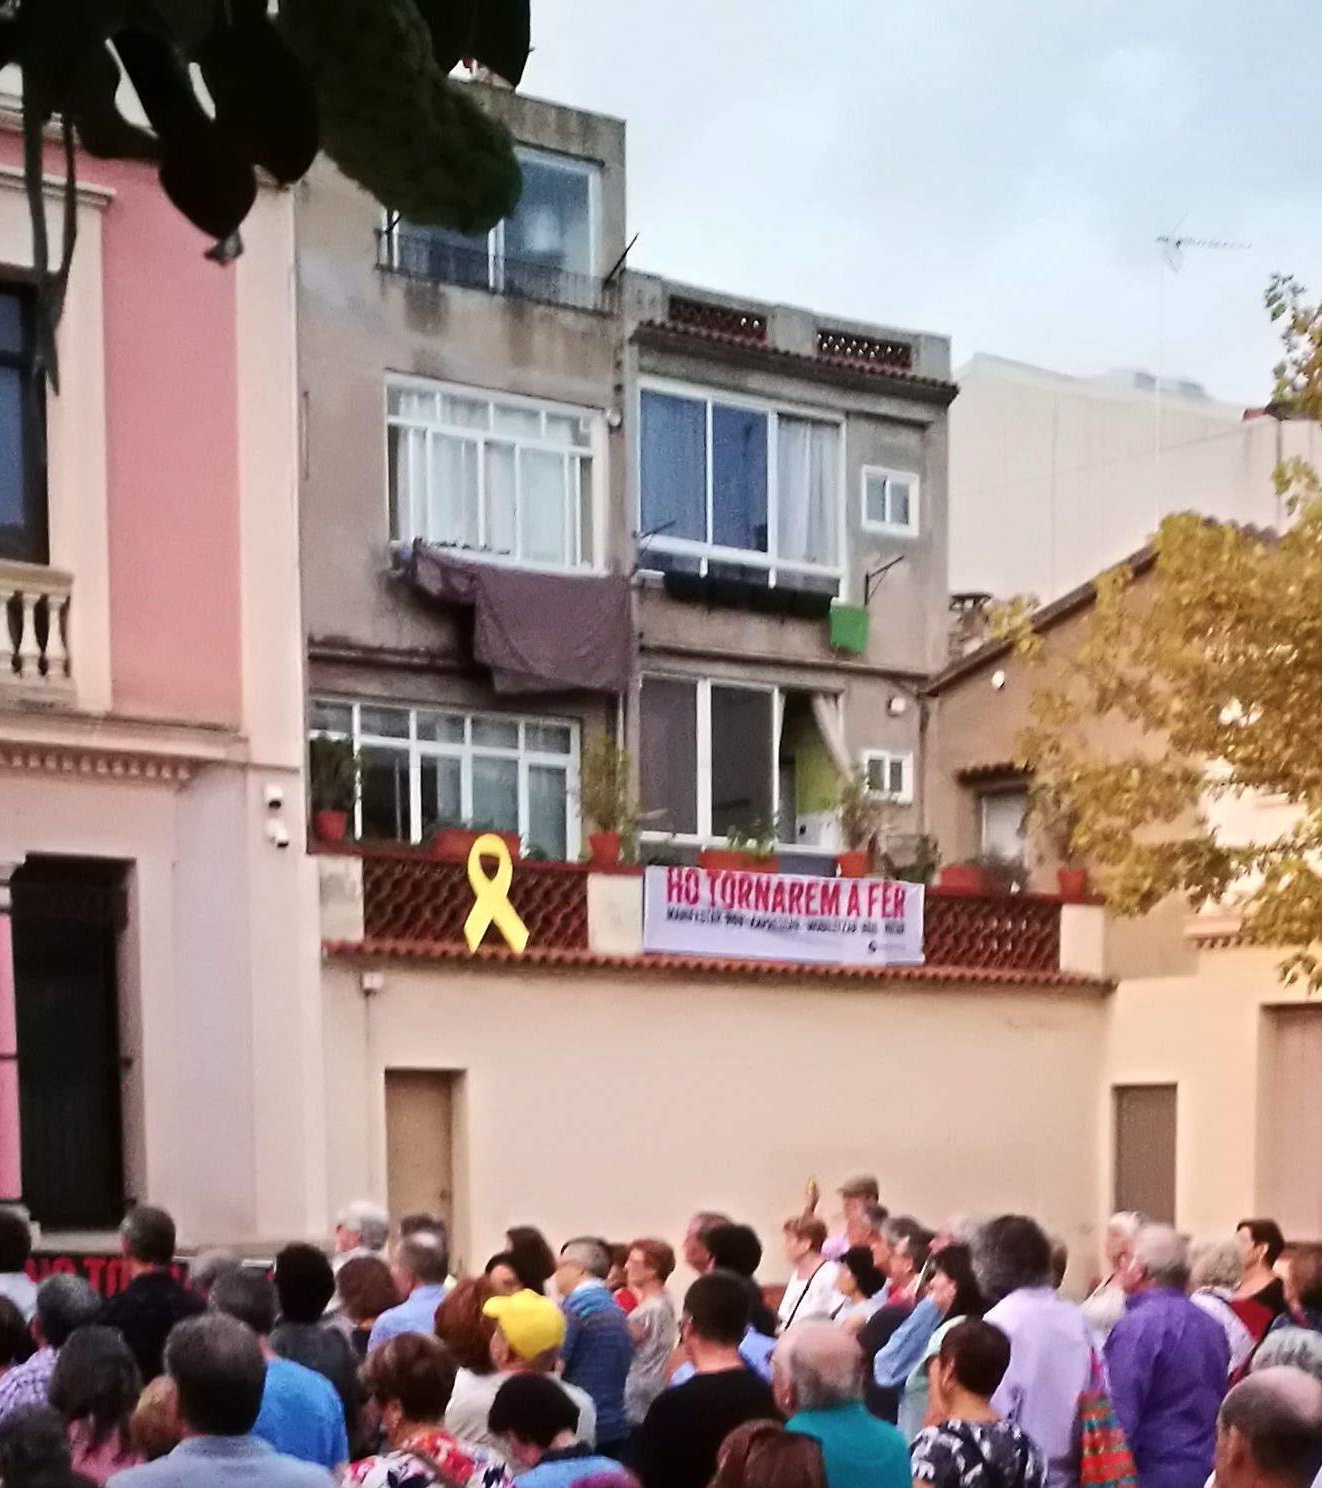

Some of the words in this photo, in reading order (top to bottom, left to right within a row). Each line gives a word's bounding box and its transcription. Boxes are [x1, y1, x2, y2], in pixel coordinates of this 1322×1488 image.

[666, 867, 699, 905] HO
[707, 870, 841, 916] TORNAREM
[847, 882, 860, 917] A
[868, 882, 906, 919] FER
